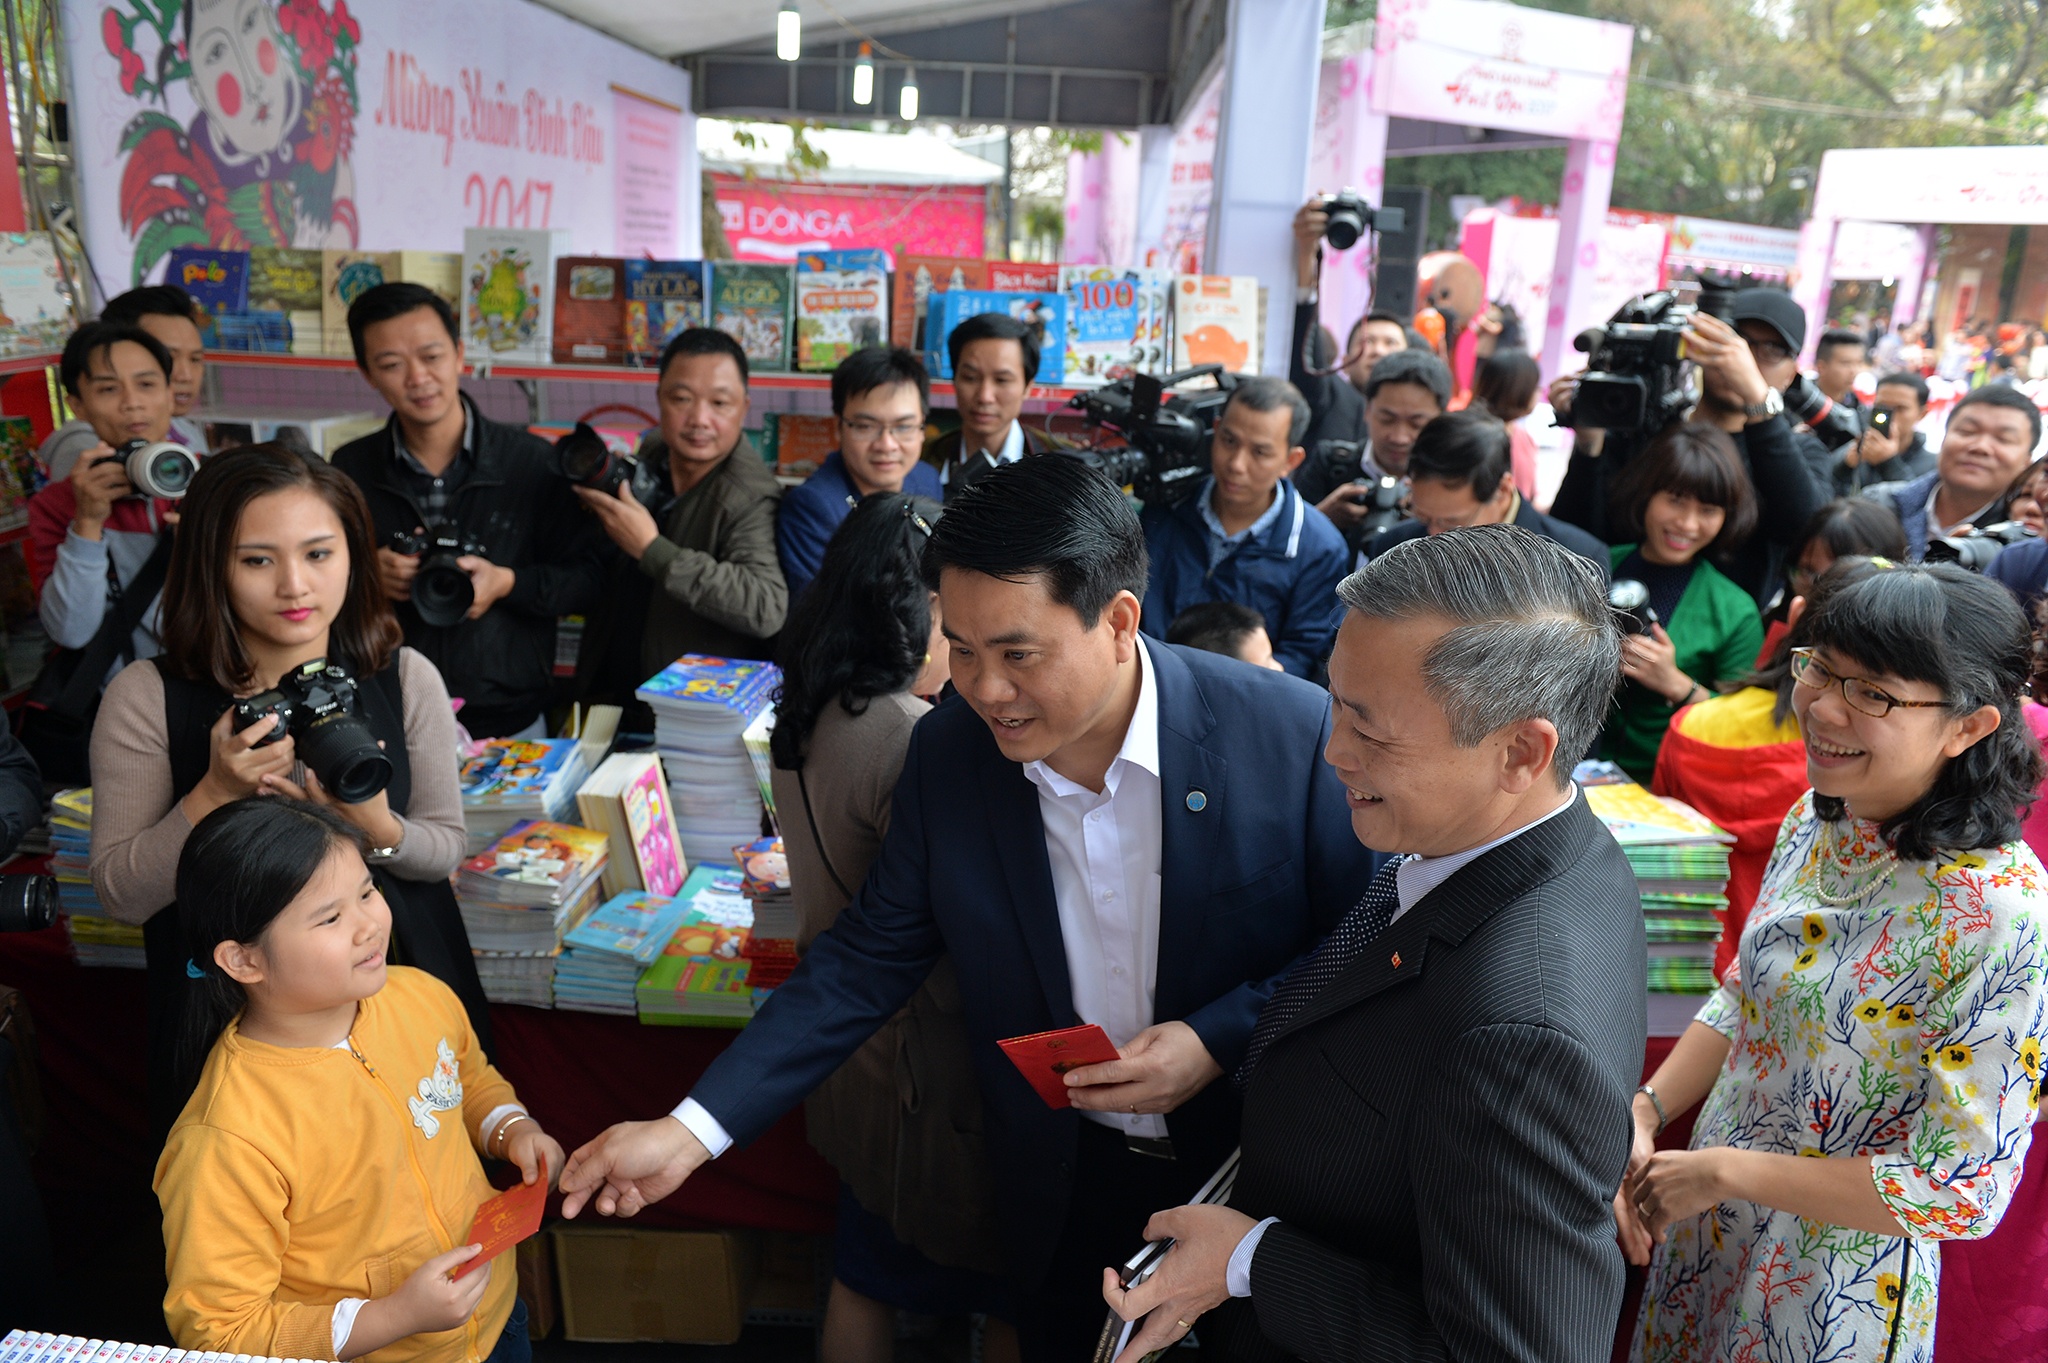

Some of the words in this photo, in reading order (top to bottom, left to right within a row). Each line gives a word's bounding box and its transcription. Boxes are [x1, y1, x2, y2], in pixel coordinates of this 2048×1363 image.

[374, 49, 454, 168] Mừng
[459, 67, 521, 149] Xuân
[464, 173, 553, 228] 2017
[1080, 282, 1134, 311] 100
[315, 701, 338, 714] Nikon
